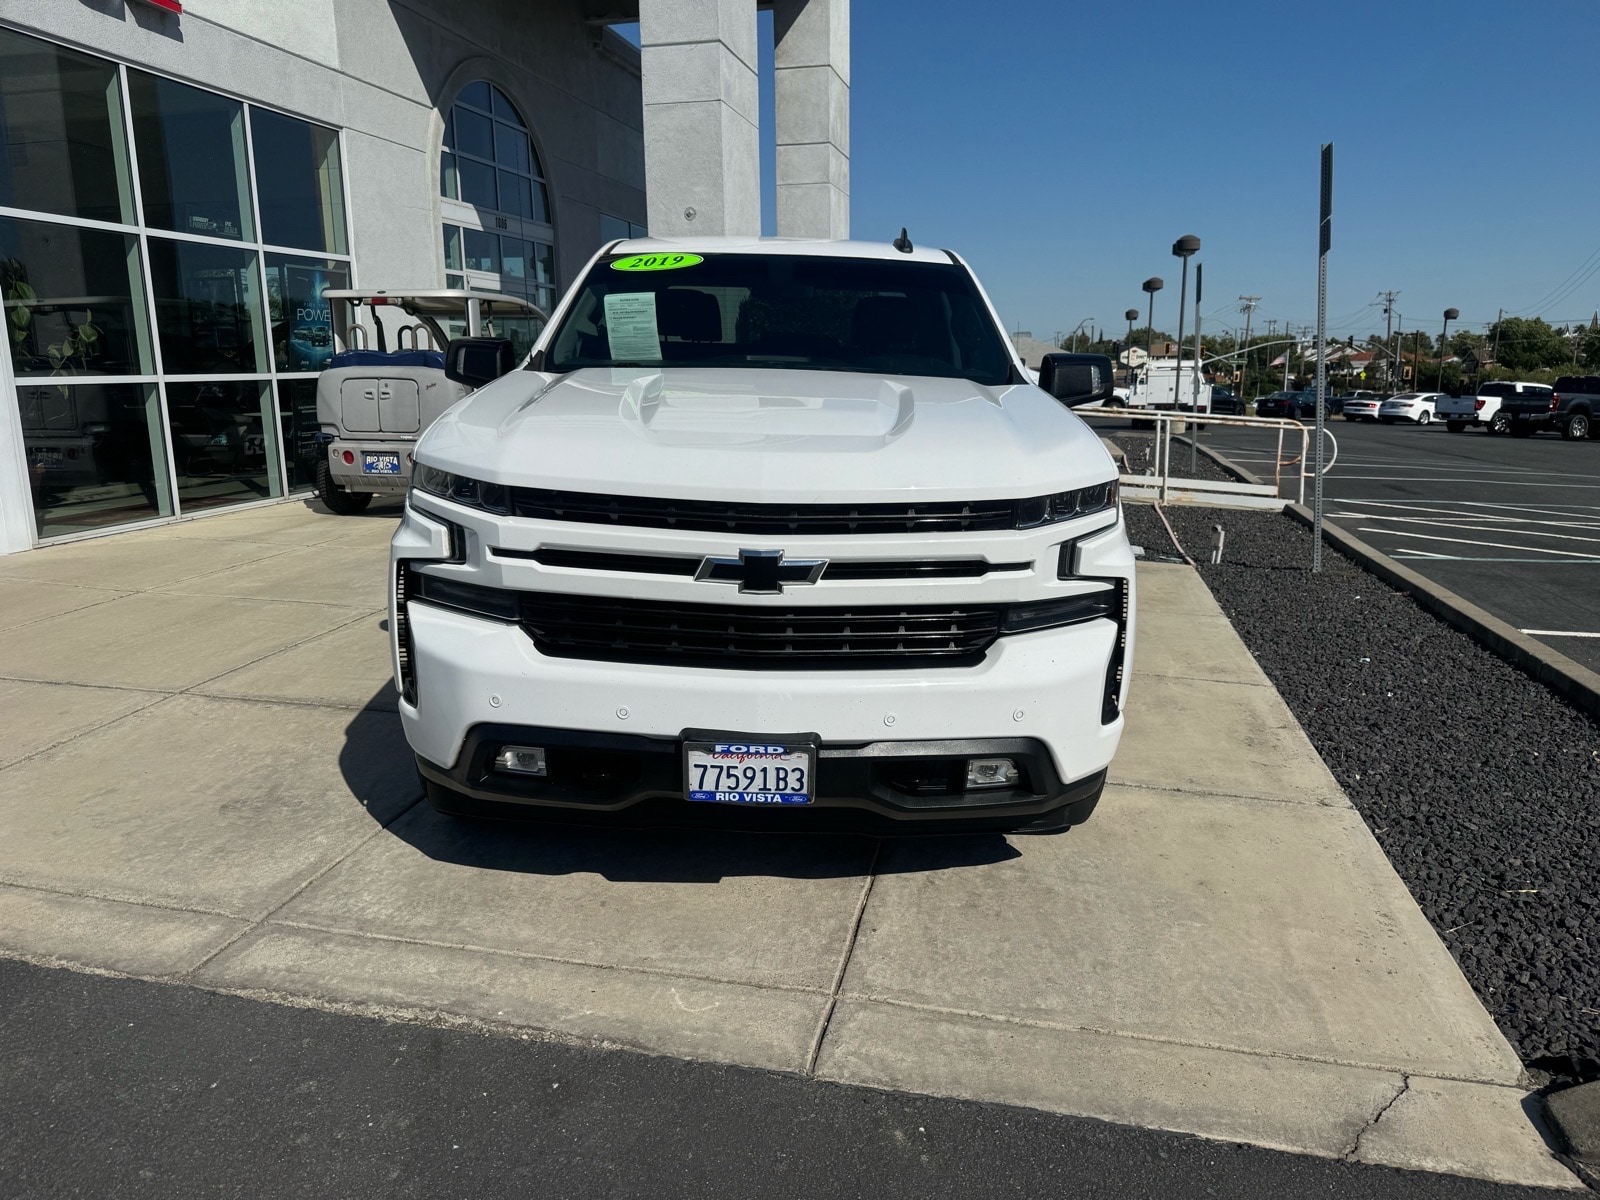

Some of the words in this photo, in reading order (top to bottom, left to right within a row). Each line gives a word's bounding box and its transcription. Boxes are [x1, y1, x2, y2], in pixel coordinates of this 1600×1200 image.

[628, 255, 684, 268] 2019
[296, 308, 331, 321] POWE
[366, 456, 378, 464] RIO
[379, 456, 398, 465] VISTA
[714, 744, 785, 754] FORD
[693, 763, 805, 792] 77591B3
[715, 792, 740, 802] RIO
[743, 793, 782, 803] VISTA
